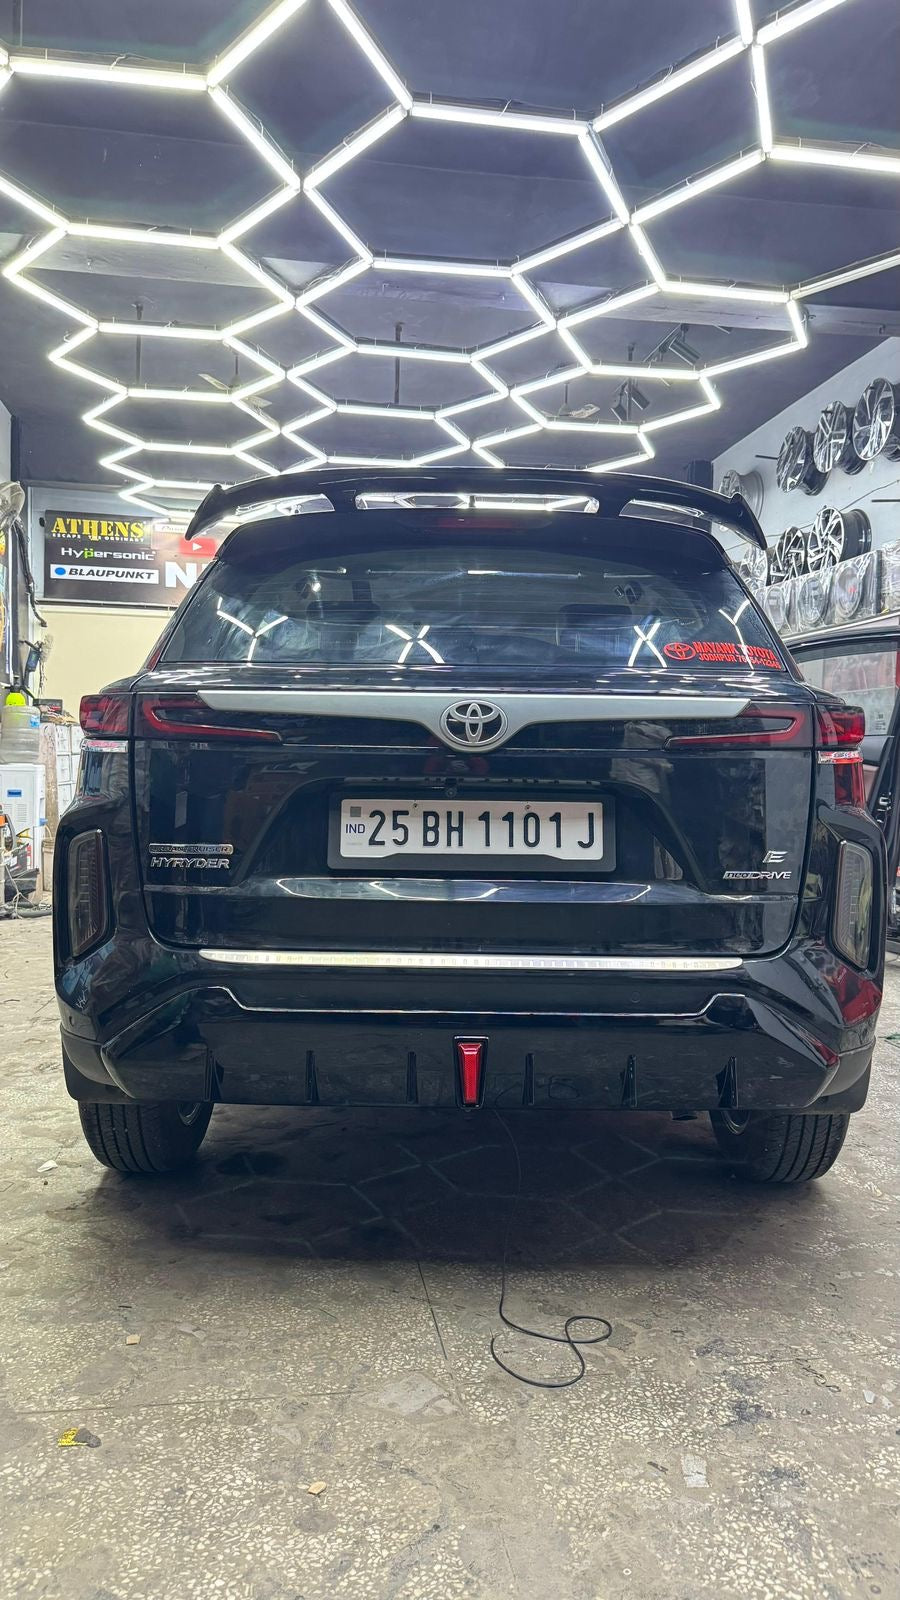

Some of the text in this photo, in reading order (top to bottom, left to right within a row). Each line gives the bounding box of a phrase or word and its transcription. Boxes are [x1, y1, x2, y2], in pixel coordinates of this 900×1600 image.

[51, 517, 145, 541] ATHENS
[61, 547, 155, 561] Hypersonic
[68, 567, 155, 580] BLAUPUNKT
[165, 561, 209, 588] N
[693, 641, 778, 661] MAYANK TOYOTA
[699, 653, 737, 663] JODHPUR
[345, 823, 366, 834] IND
[368, 810, 595, 849] 25 BH 1101 J
[150, 857, 230, 869] HYRYDER
